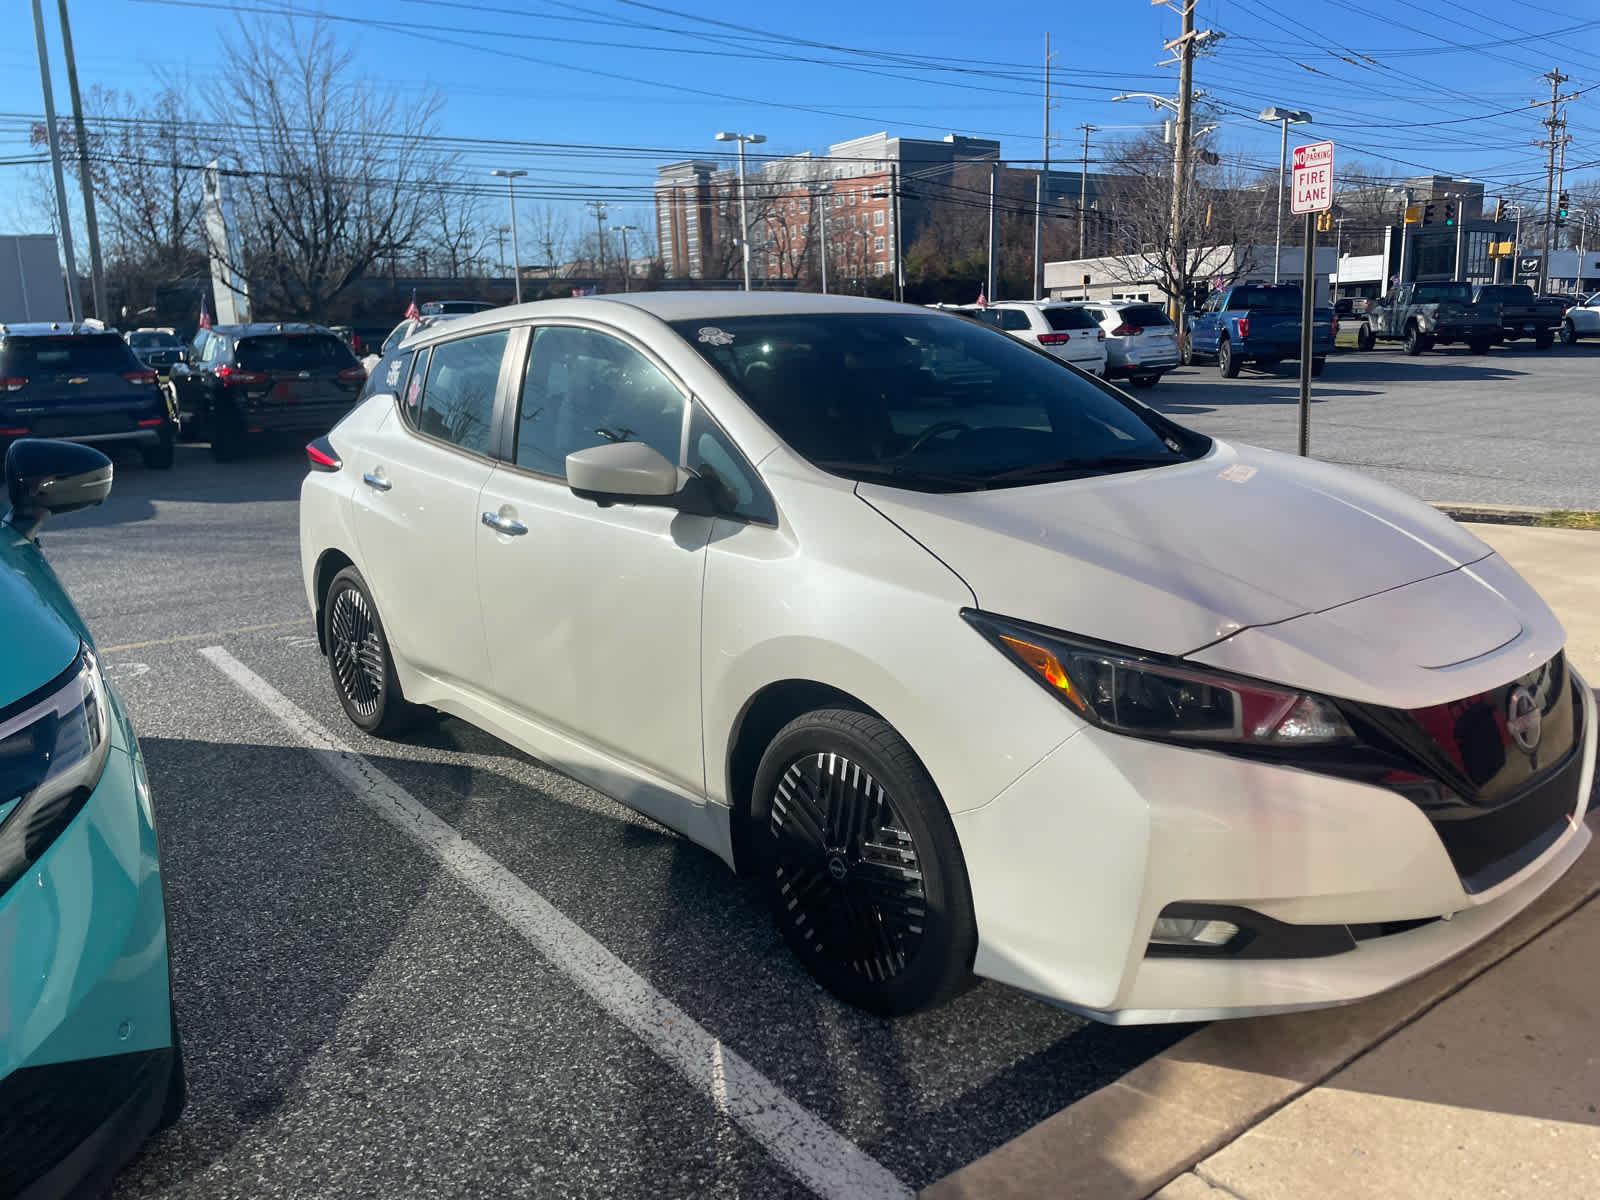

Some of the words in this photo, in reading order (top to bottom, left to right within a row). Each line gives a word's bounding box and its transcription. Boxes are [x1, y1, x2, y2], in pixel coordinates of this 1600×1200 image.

[1295, 152, 1305, 166] NO
[1306, 151, 1330, 161] PARKING
[1299, 170, 1325, 186] FIRE
[1298, 187, 1327, 203] LANE
